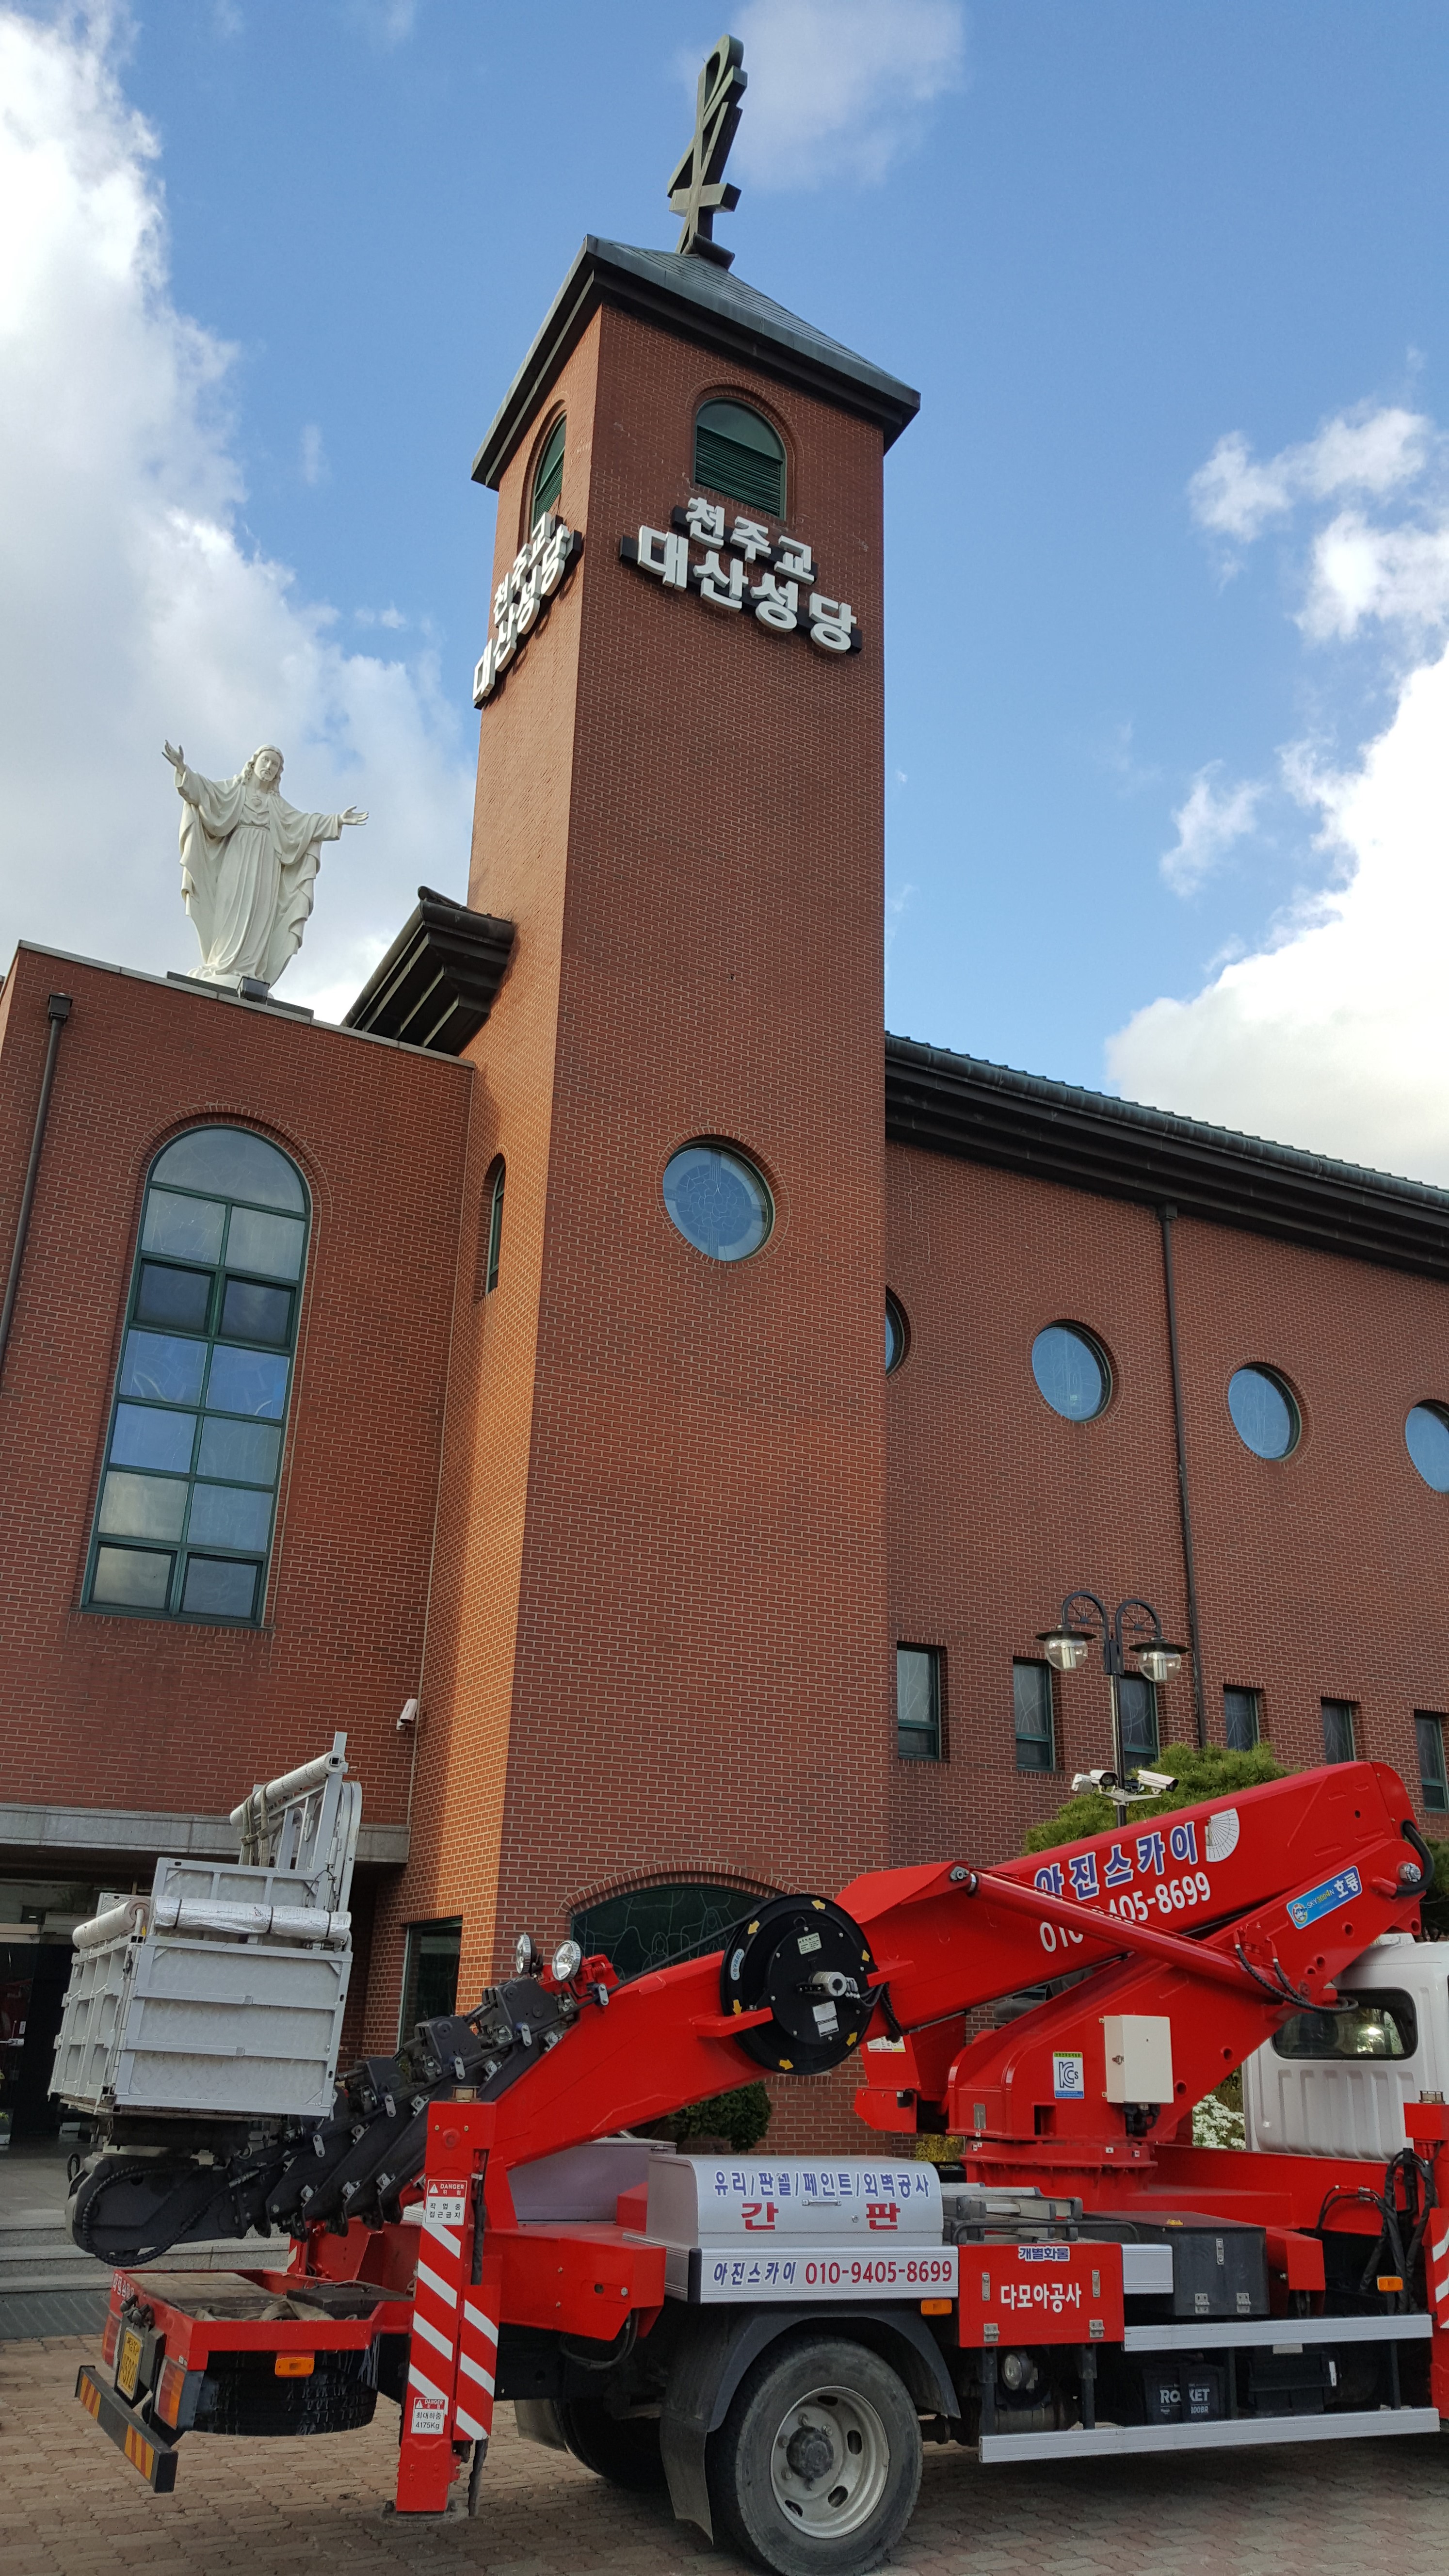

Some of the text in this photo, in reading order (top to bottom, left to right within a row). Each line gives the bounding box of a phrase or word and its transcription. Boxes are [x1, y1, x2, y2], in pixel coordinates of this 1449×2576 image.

[685, 497, 814, 584] 천주교
[494, 512, 552, 627] 천주교
[637, 525, 857, 654] 대산성당
[472, 524, 570, 702] 대산성당
[741, 2202, 901, 2230] 간 판
[1019, 2246, 1070, 2261] 개별화물
[713, 2260, 952, 2286] 아진스카이 010-9405-8699
[1001, 2283, 1082, 2313] 다모아공사
[416, 2421, 440, 2430] 4175Kg
